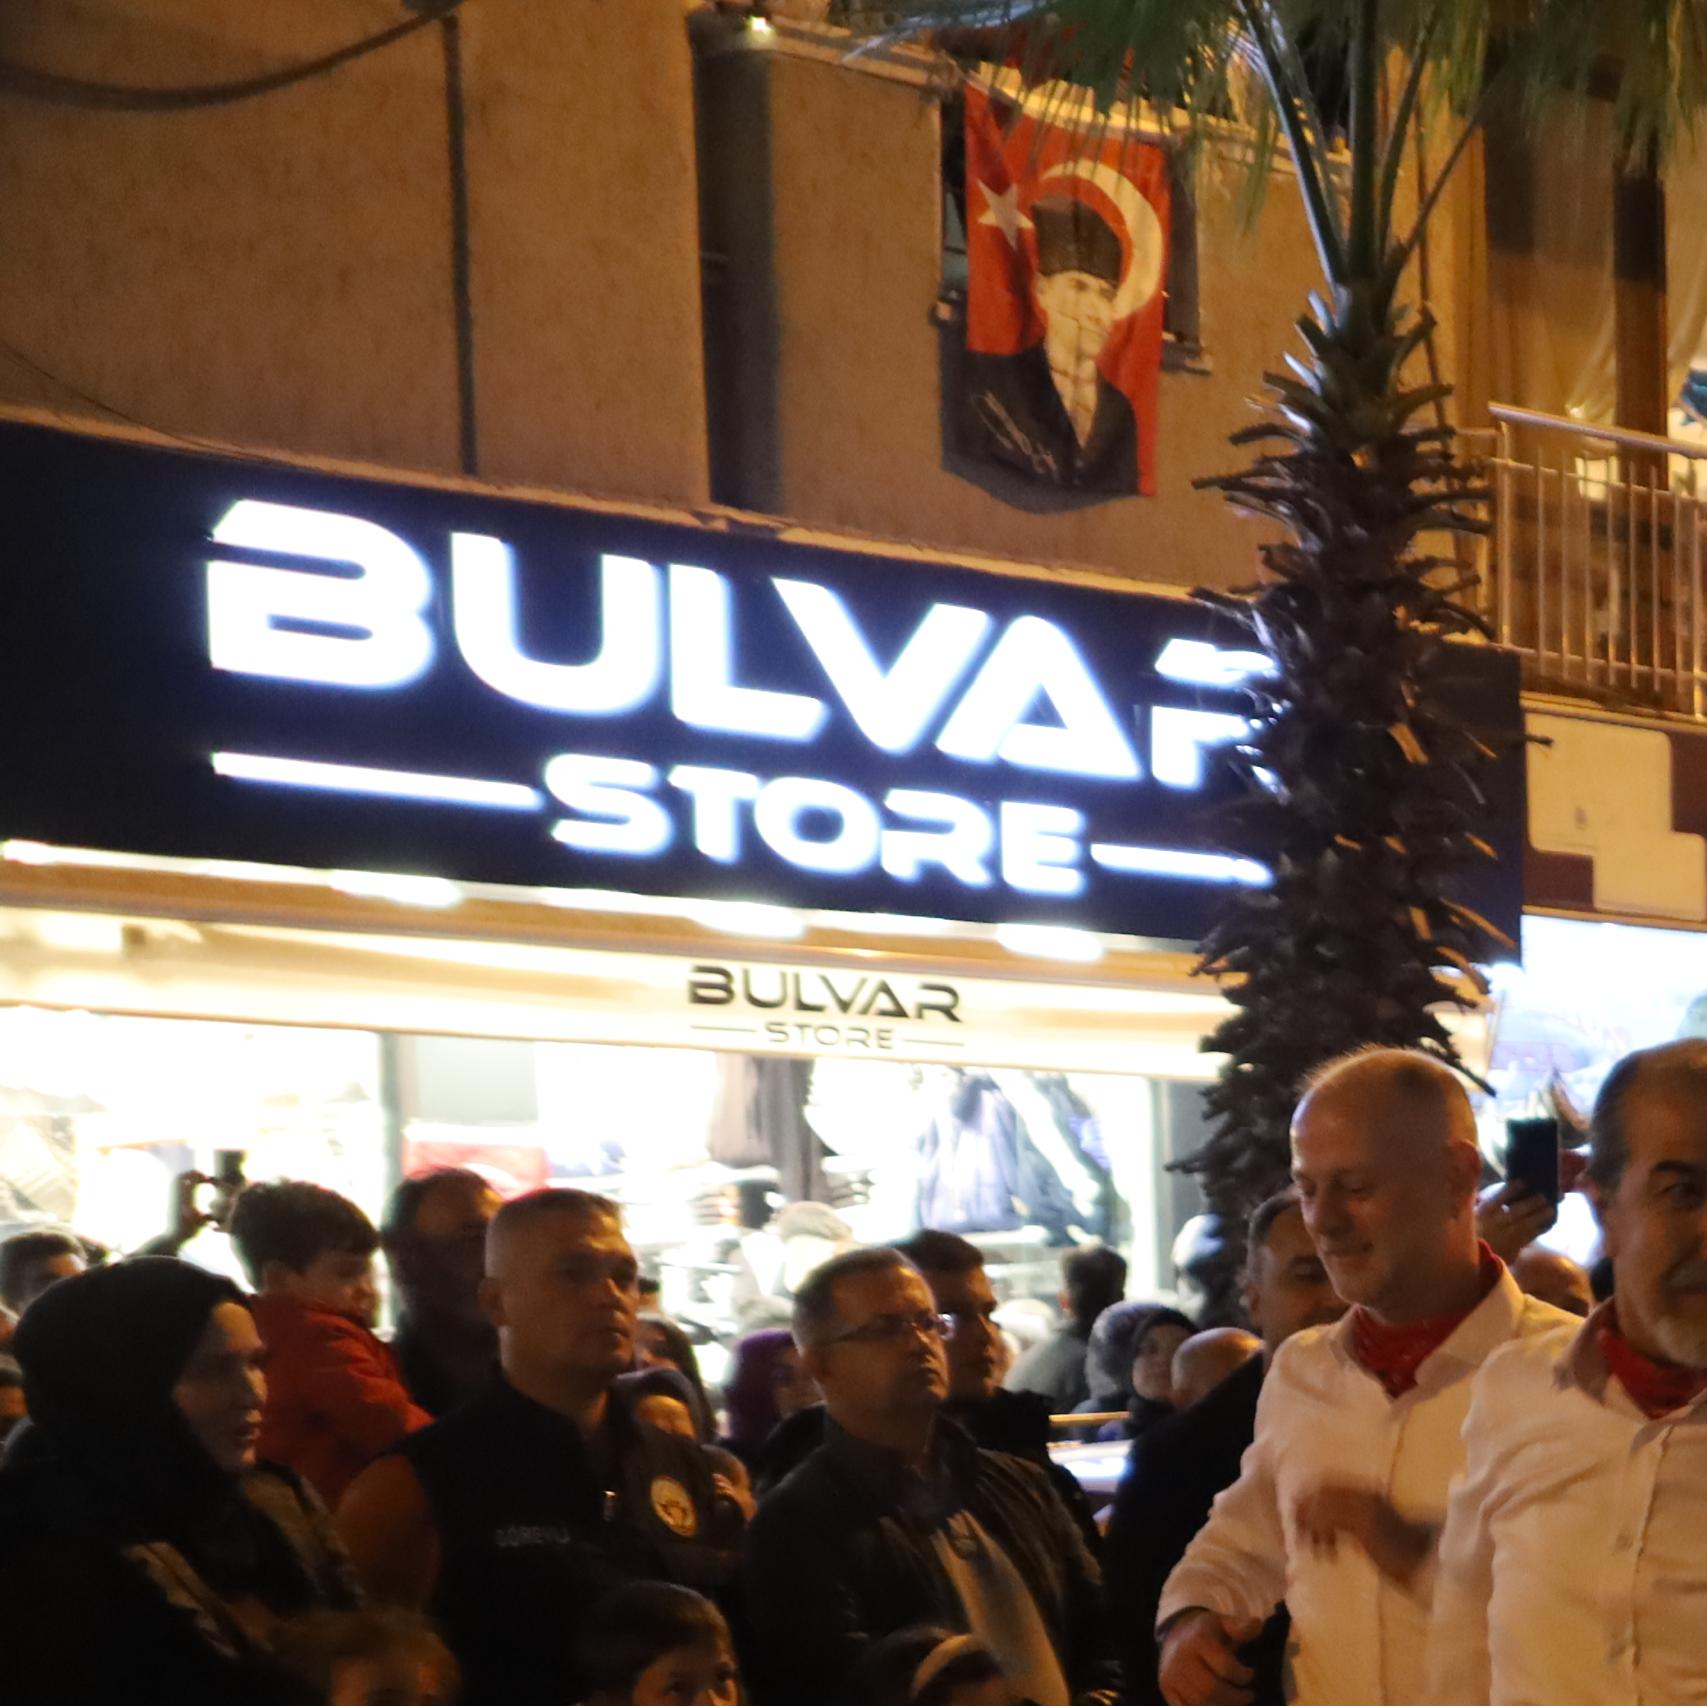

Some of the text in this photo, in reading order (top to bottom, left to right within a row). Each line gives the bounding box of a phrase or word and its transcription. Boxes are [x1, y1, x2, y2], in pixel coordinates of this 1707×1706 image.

[544, 752, 1090, 897] STORE
[687, 965, 963, 1025] BULVAR
[764, 1022, 894, 1050] STORE
